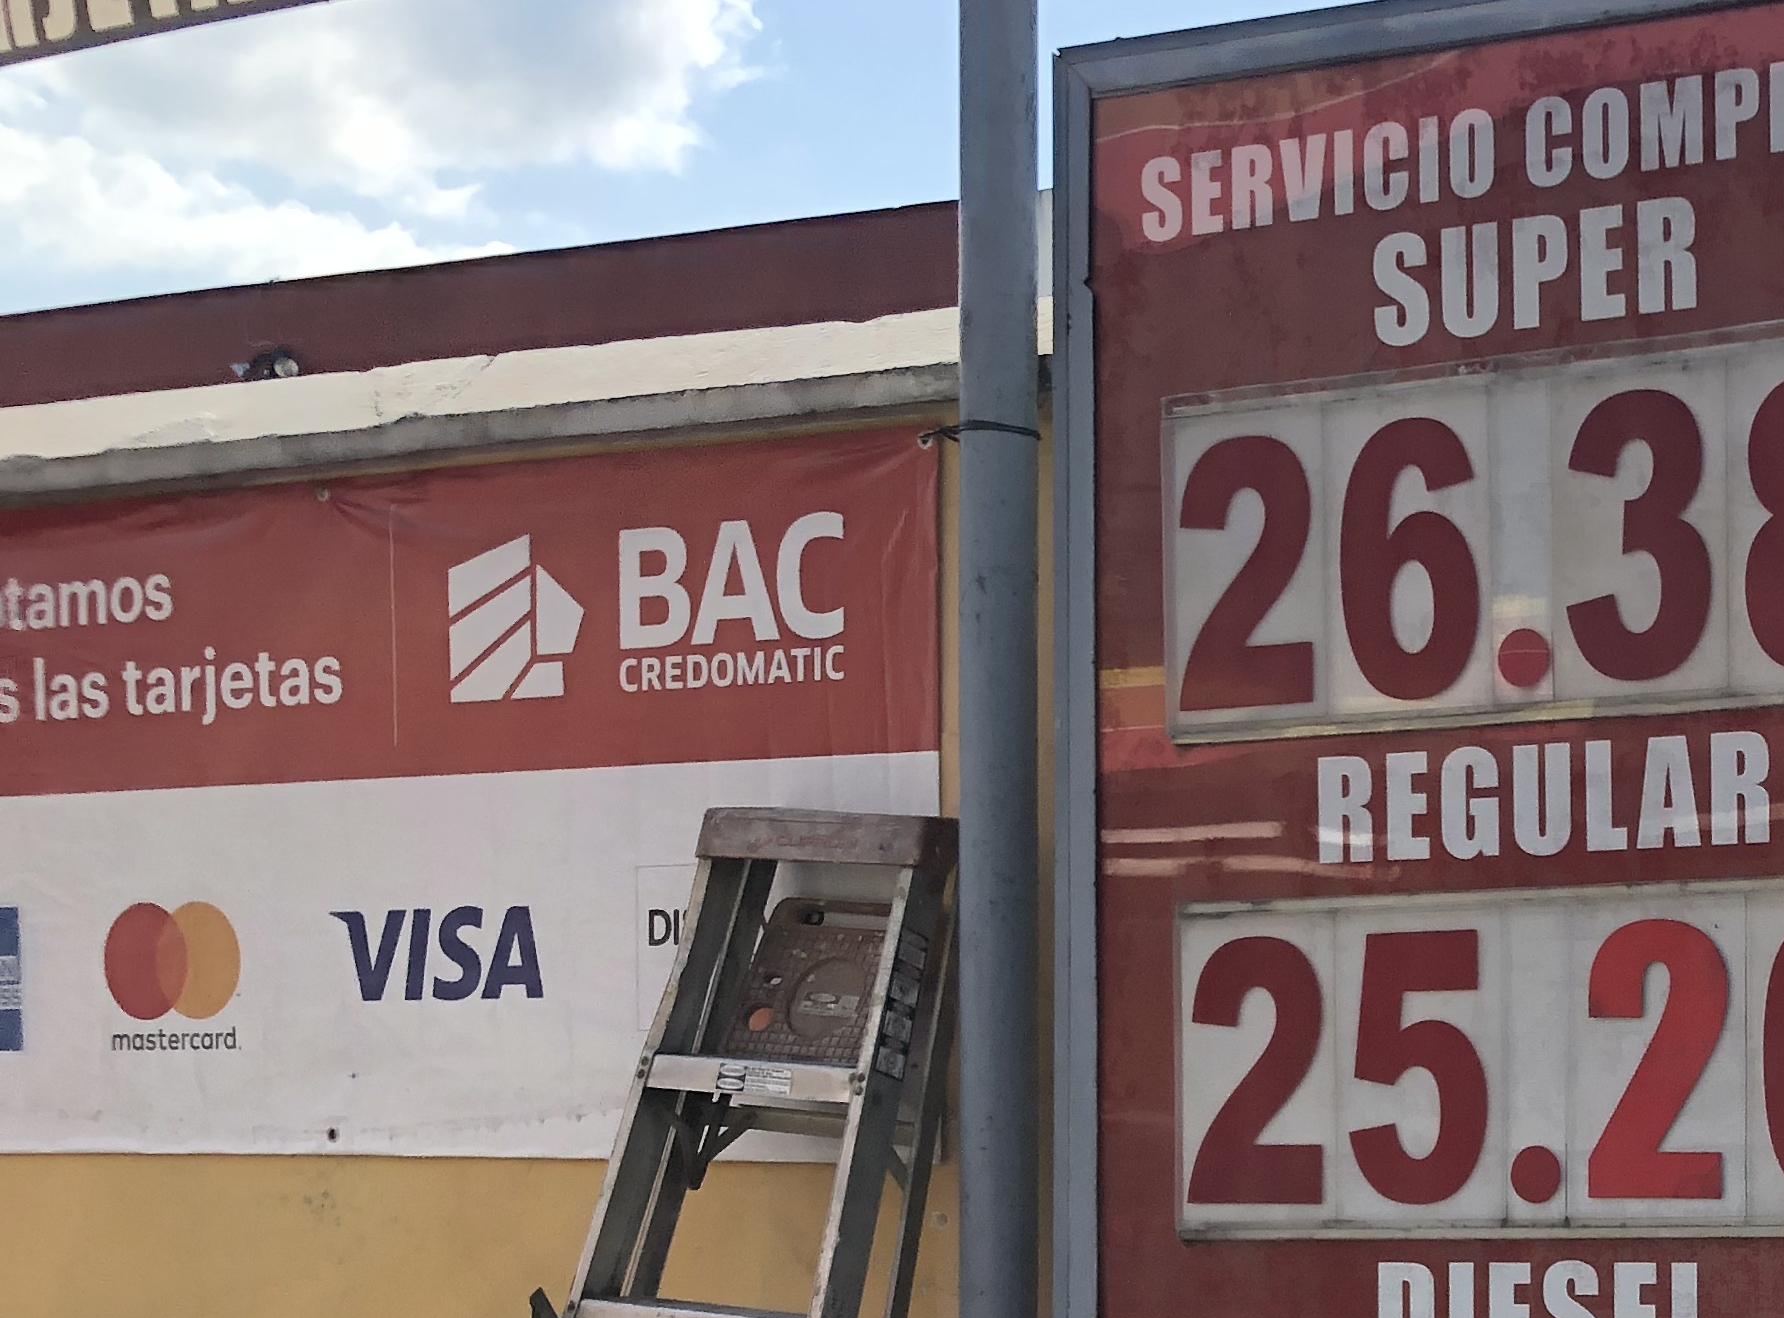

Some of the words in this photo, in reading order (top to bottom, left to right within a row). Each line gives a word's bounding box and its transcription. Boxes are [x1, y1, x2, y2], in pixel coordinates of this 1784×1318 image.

[1141, 107, 1495, 243] SERVICIO
[1372, 196, 1698, 347] SUPER
[0, 573, 173, 631] tamos
[619, 511, 845, 650] BAC
[33, 656, 110, 722] las
[121, 645, 343, 726] tarjetas
[619, 645, 846, 693] CREDOMATIC
[1317, 730, 1770, 865] REGULAR
[328, 905, 544, 1001] VISA
[648, 908, 688, 946] DI
